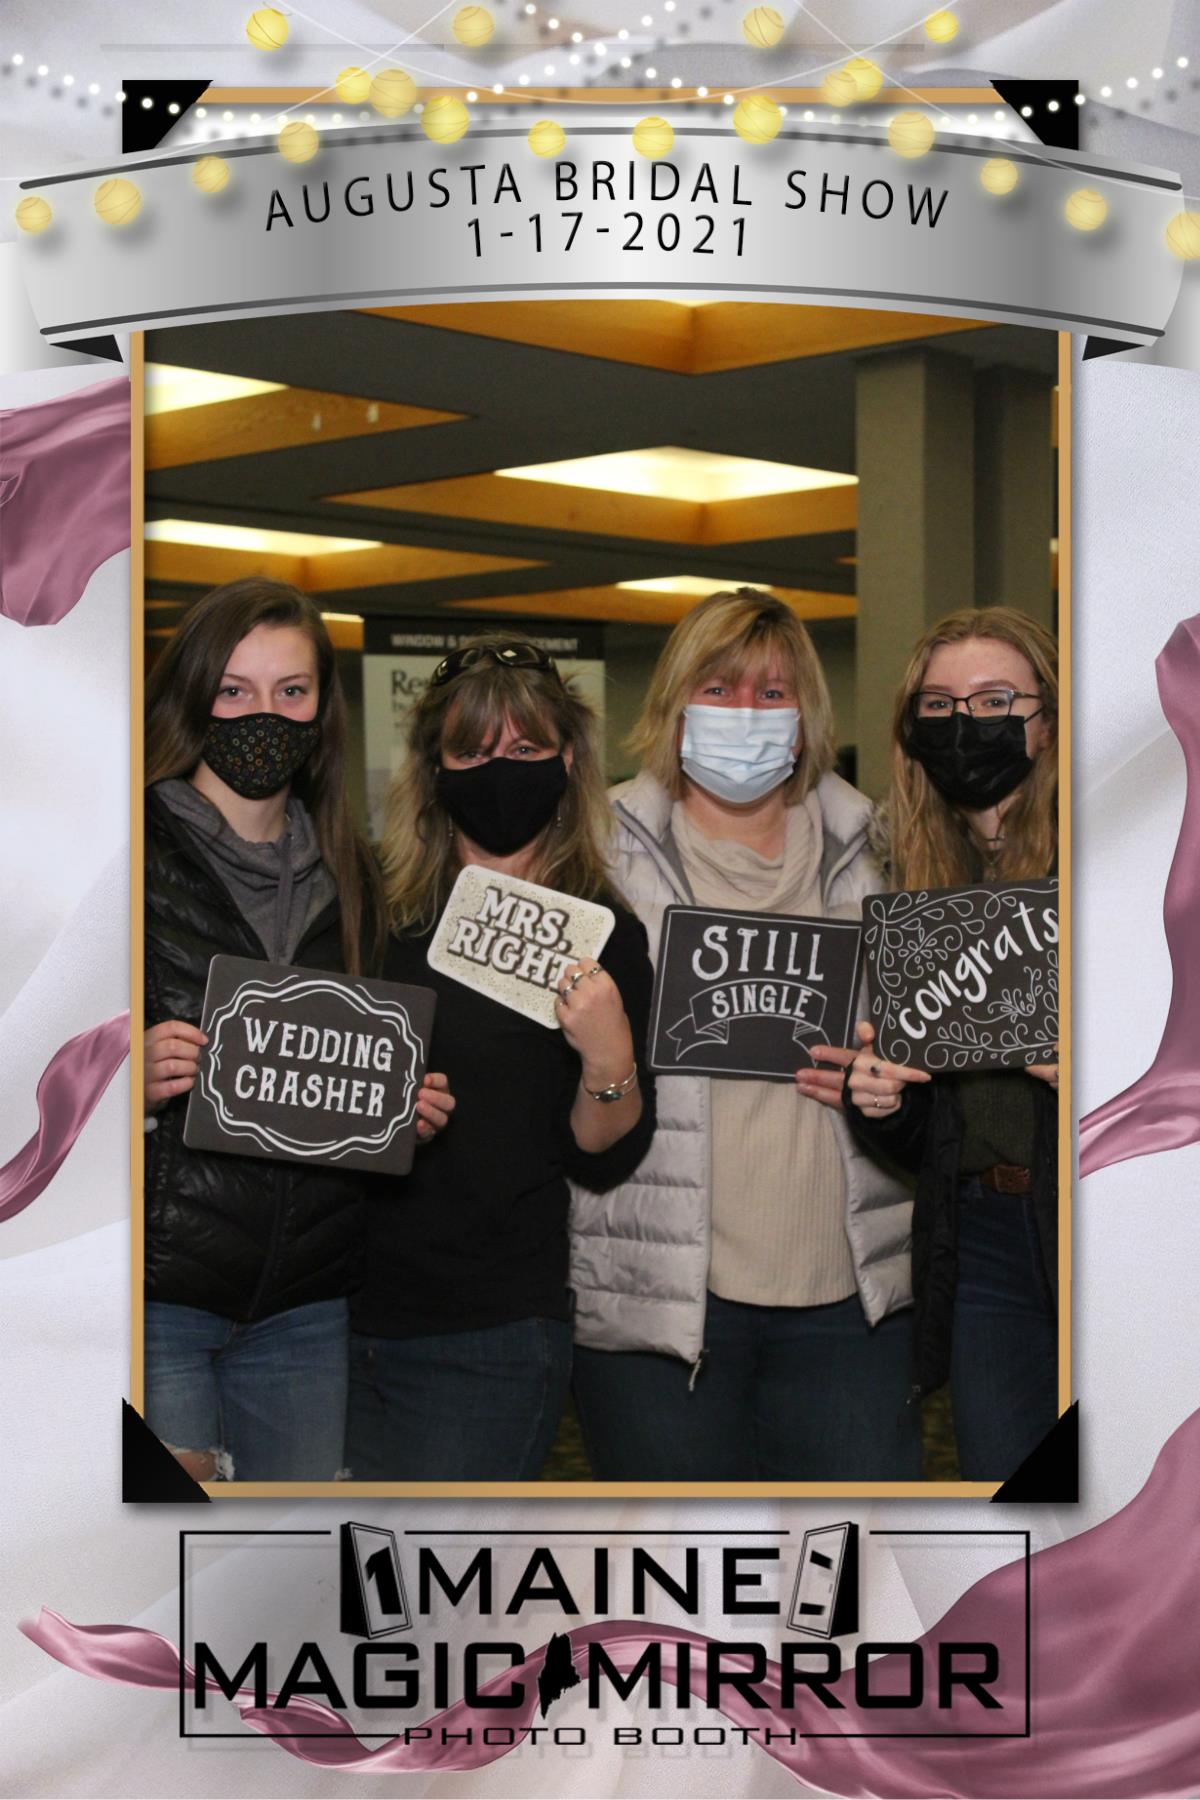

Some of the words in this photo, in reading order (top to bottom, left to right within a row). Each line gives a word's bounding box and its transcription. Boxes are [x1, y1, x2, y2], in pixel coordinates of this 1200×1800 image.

[476, 885, 573, 955] MRS.
[691, 925, 824, 981] STILL
[899, 901, 1058, 1040] congrats
[711, 984, 812, 1018] SINGLE
[242, 1016, 394, 1072] WEDDING
[234, 1064, 386, 1117] CRASHER
